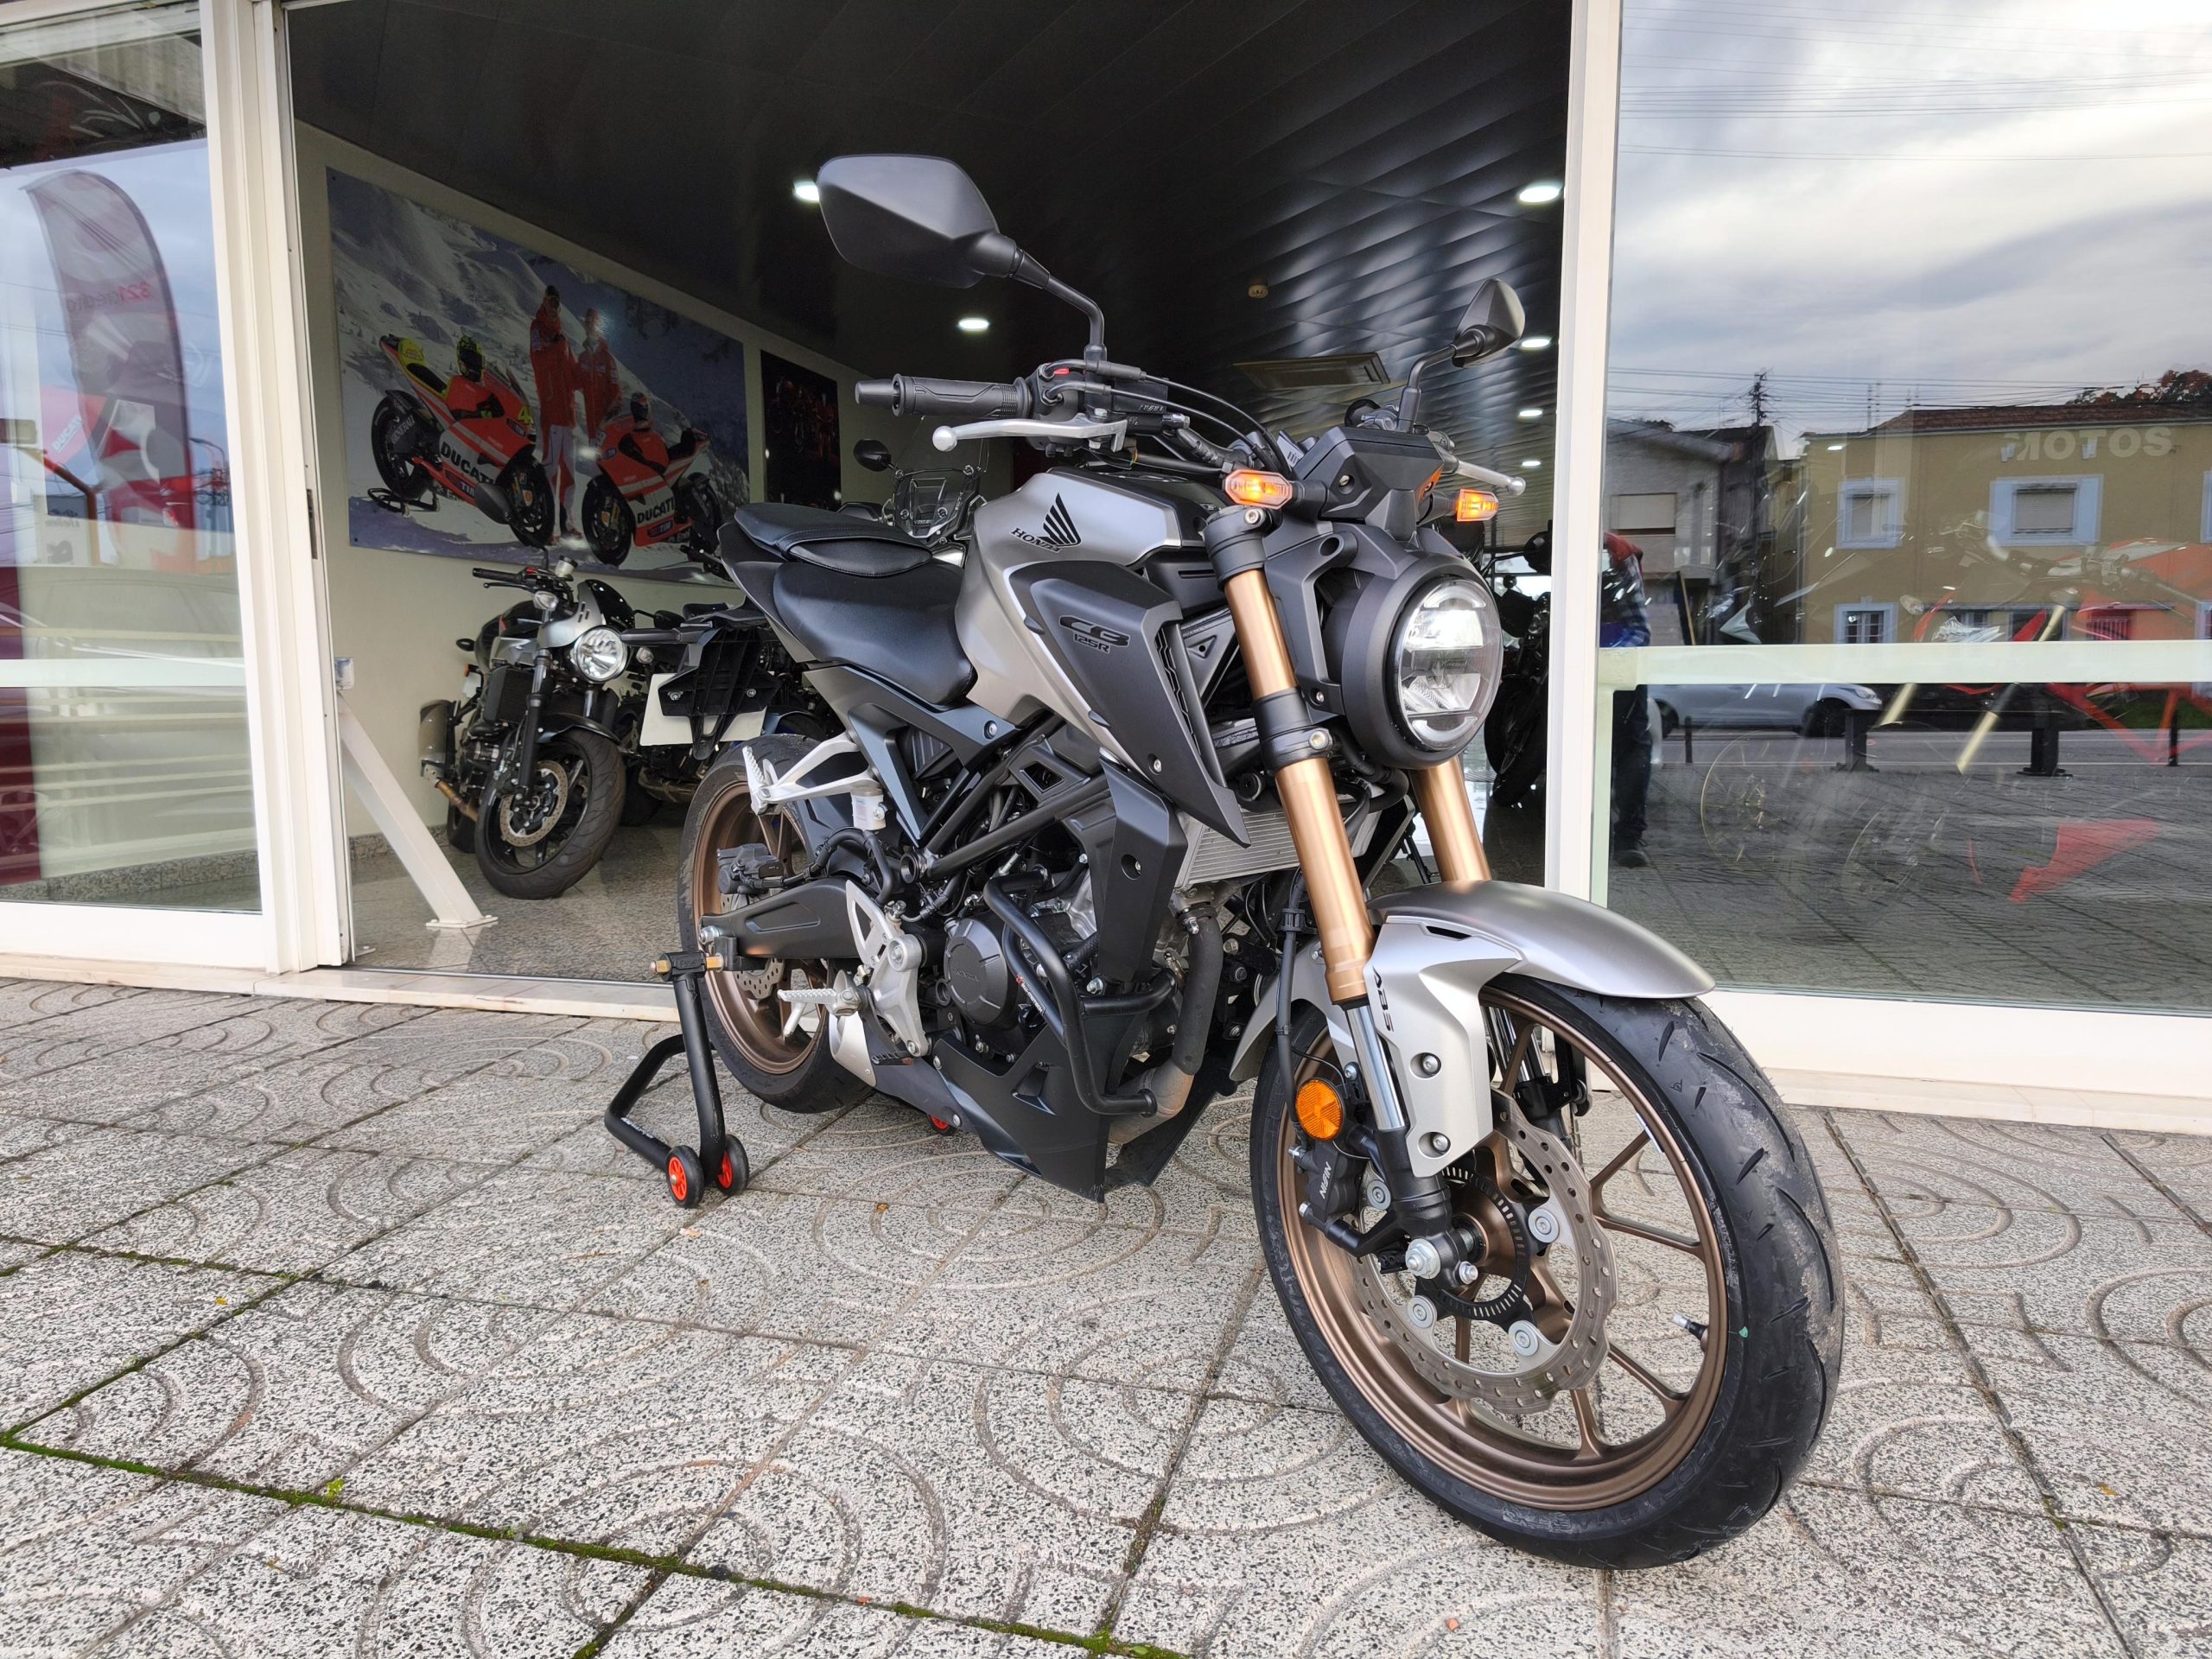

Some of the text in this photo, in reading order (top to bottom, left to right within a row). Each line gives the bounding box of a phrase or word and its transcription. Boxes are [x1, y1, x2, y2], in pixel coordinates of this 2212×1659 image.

[637, 498, 675, 524] DUCATI
[1011, 527, 1061, 552] HONDA
[1059, 615, 1130, 645] CB
[1074, 633, 1109, 653] 125R
[1372, 965, 1394, 1032] ABS
